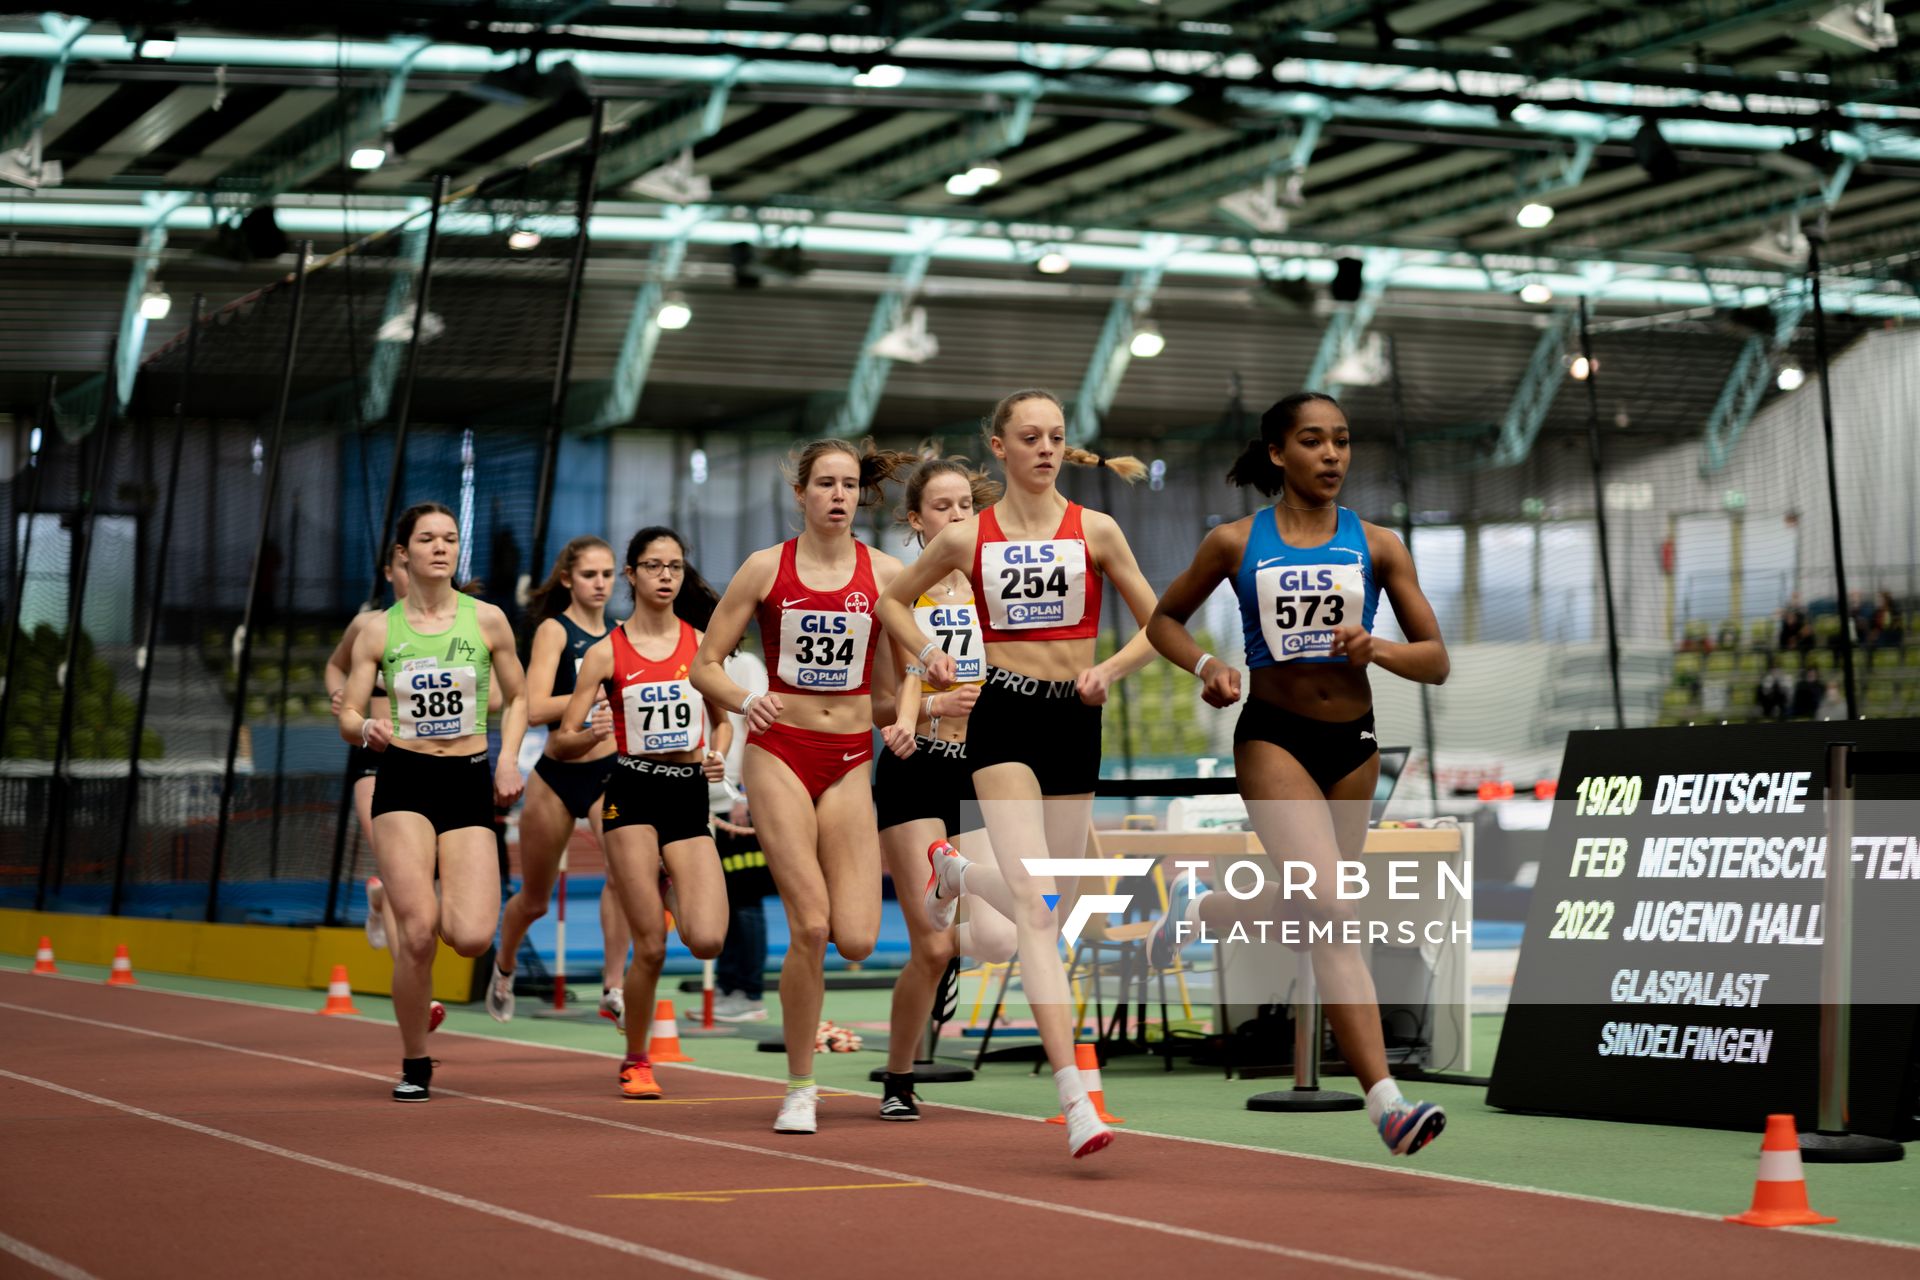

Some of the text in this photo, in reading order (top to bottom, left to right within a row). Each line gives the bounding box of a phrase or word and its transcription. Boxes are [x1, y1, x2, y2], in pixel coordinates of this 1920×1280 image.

[1000, 566, 1068, 600] 254
[1030, 605, 1061, 615] PLAN
[1276, 595, 1344, 629] 573
[795, 636, 854, 666] 334
[936, 629, 972, 656] 77
[1304, 633, 1335, 644] PLAN
[819, 672, 846, 681] PLAN
[990, 668, 1039, 696] PRO
[410, 690, 463, 718] 388
[638, 703, 691, 731] 719
[434, 720, 459, 730] PLAN
[663, 733, 687, 743] PLAN
[653, 765, 694, 777] PRO
[1576, 775, 1642, 816] 19/20
[1651, 772, 1812, 815] DEUTSCHE
[1569, 836, 1920, 879] FEB MEISTERSCHFTEN
[1548, 900, 1824, 945] 2022 JUGEND HALL
[1610, 969, 1770, 1008] GLASPALAST
[1598, 1021, 1774, 1064] SINDELFINGEN
